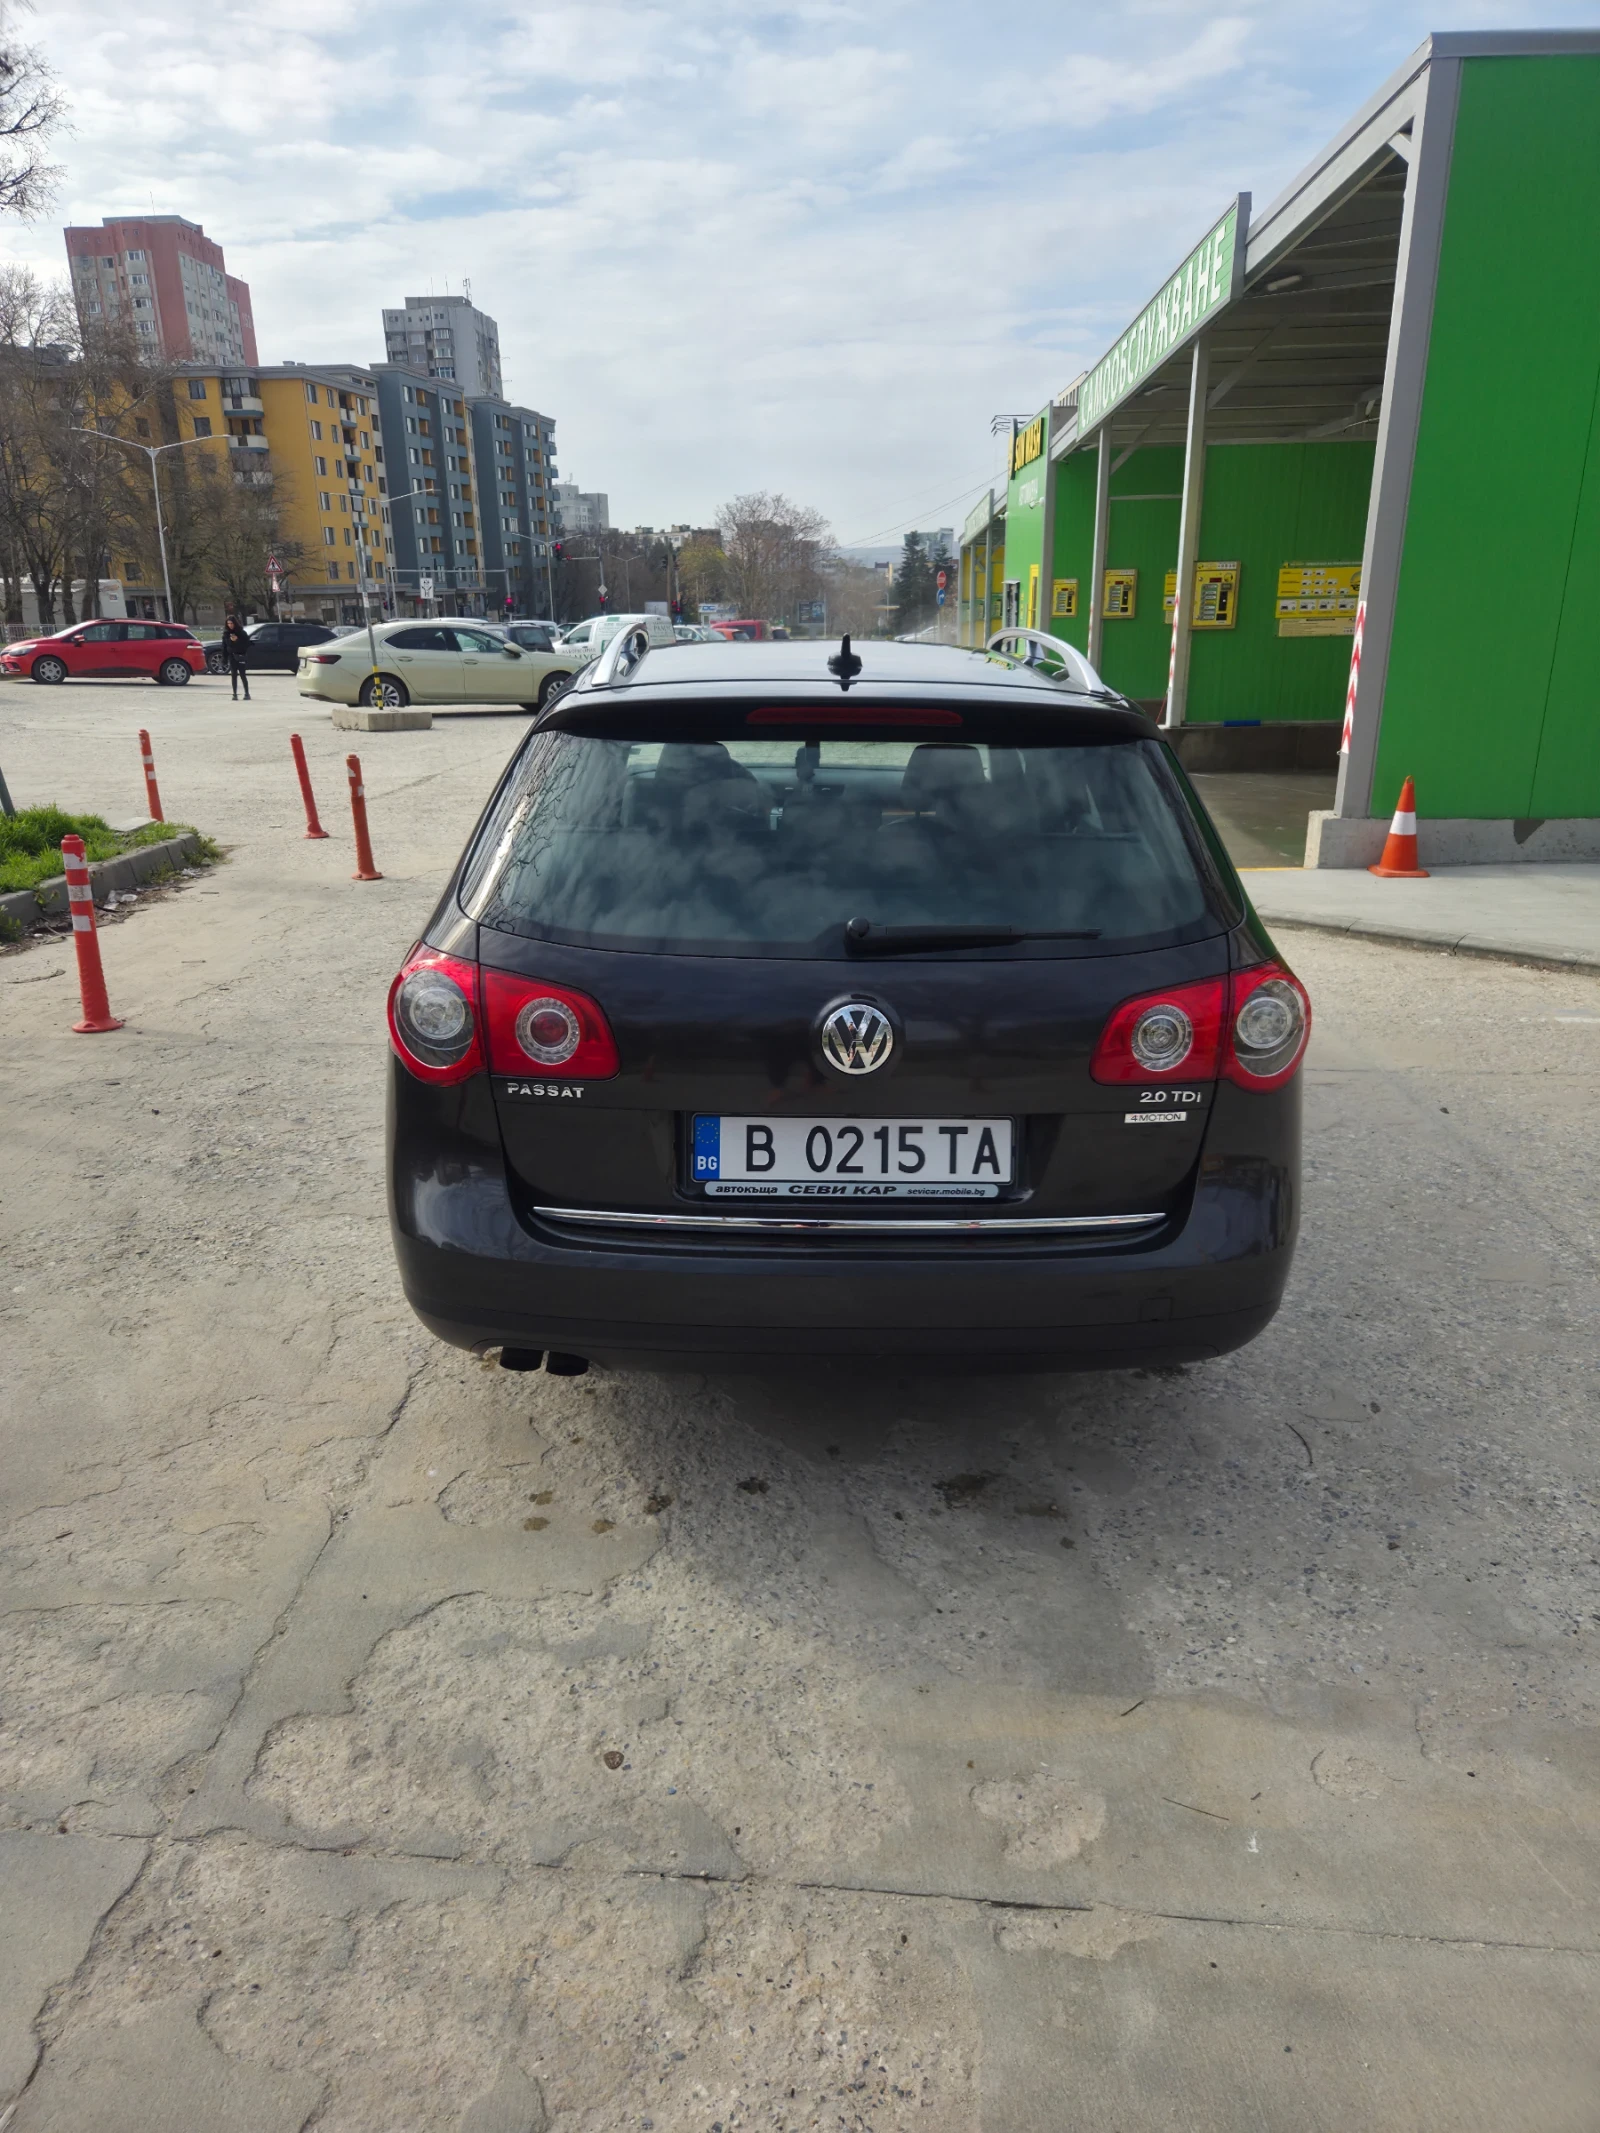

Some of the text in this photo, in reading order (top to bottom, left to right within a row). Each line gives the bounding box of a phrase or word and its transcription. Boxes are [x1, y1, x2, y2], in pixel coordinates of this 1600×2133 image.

[1081, 224, 1226, 428] САМООБСЛУЖВАНЕ
[507, 1082, 584, 1099] PASSAT
[1130, 1113, 1181, 1122] 4MOTION
[746, 1125, 1000, 1174] B 0215 TA
[697, 1156, 717, 1170] BG
[715, 1185, 897, 1195] автокъща СЕВИ КАР
[907, 1187, 985, 1197] sevicar.mobile.bg
